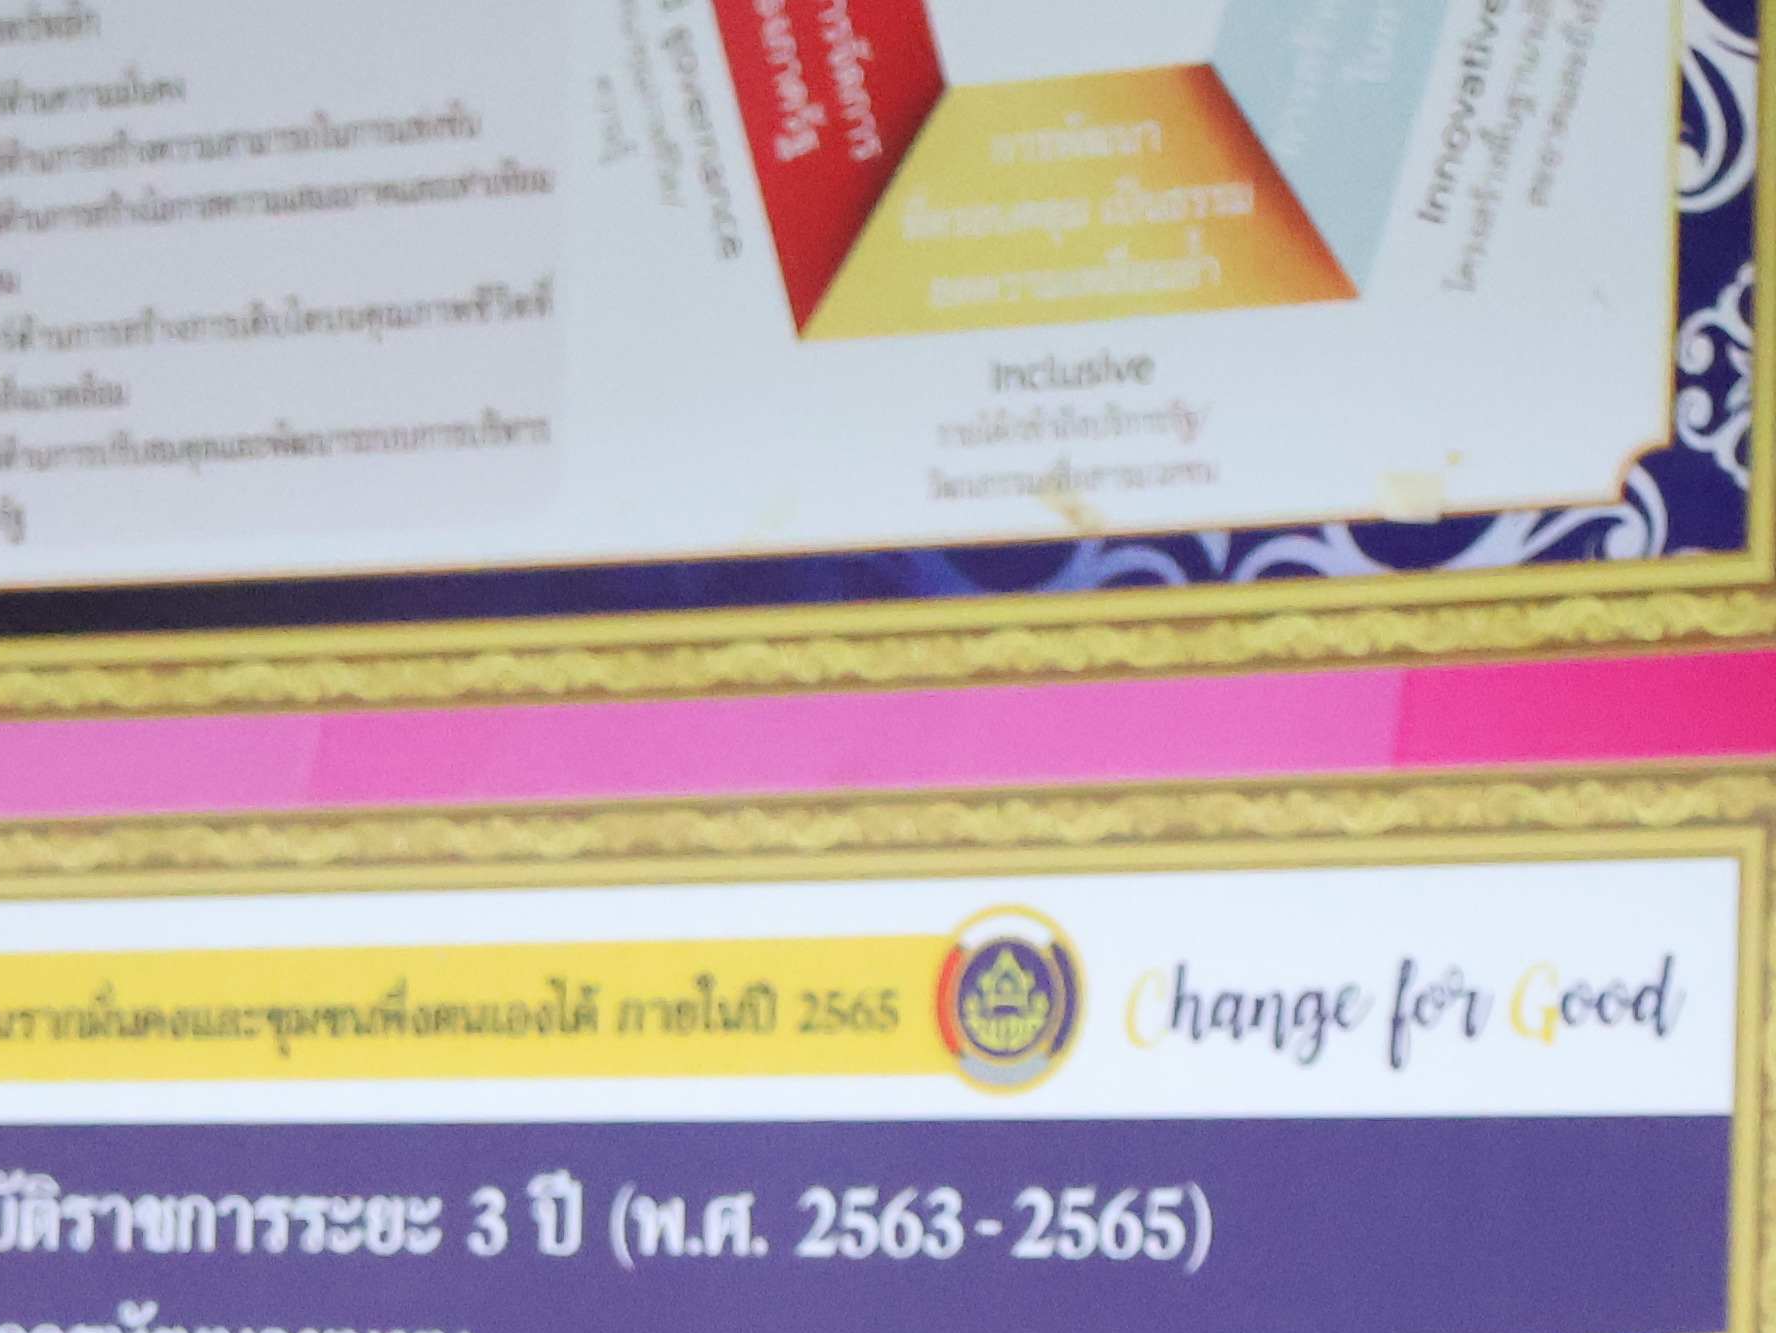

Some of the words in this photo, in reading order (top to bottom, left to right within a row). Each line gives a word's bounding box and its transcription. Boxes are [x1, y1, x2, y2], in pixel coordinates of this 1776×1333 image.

[988, 347, 1155, 393] Inclusive
[795, 987, 901, 1037] 2565
[1123, 961, 1363, 1067] Change
[1386, 956, 1494, 1068] for
[1508, 955, 1678, 1045] Good
[466, 1185, 508, 1257] 3
[531, 1169, 583, 1258] ปี
[608, 1180, 767, 1270] (พ.ศ.
